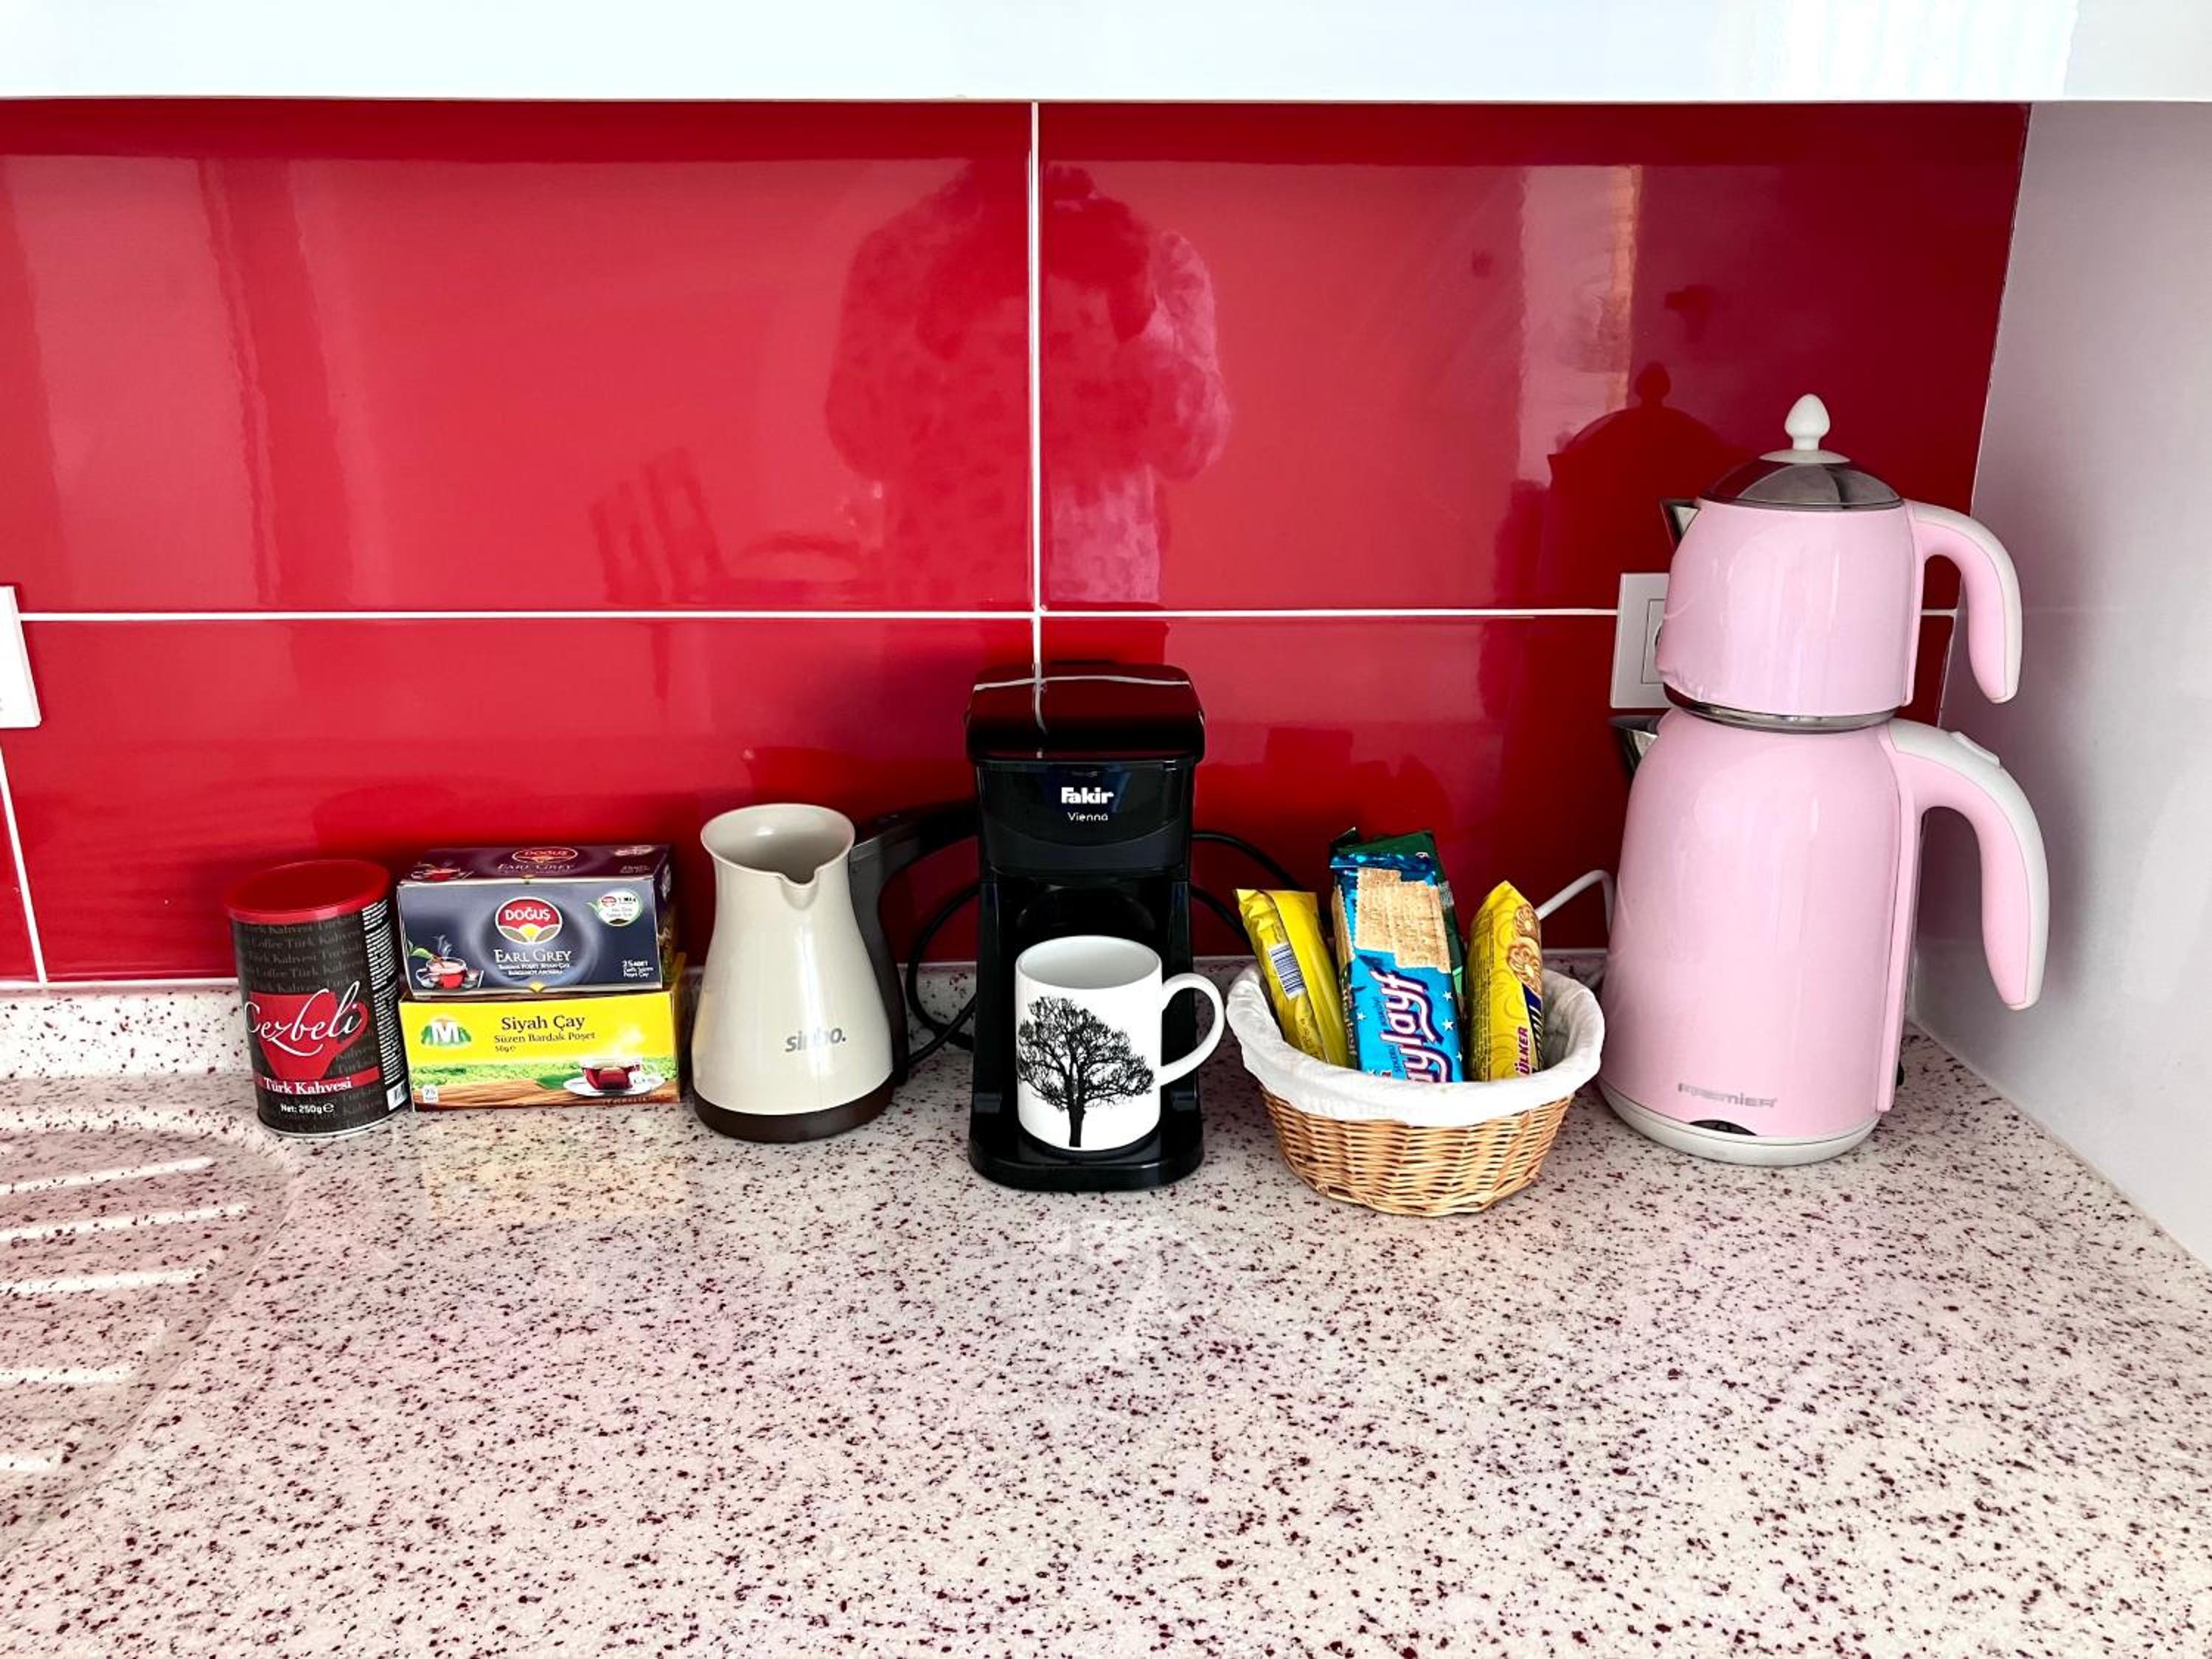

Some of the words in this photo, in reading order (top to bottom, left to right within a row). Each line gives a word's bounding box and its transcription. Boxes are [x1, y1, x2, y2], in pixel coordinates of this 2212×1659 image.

[1061, 787, 1114, 804] Fakir
[1067, 812, 1108, 821] Vienna
[504, 906, 551, 922] DOĞUŞ
[501, 1016, 548, 1033] Siyah
[553, 1015, 585, 1031] Çay
[494, 1034, 526, 1043] Süzen
[528, 1032, 566, 1042] Bardak
[568, 1031, 595, 1041] Poşet
[785, 1027, 846, 1052] sio.
[1514, 1026, 1530, 1075] ÜLKER
[264, 1077, 293, 1095] Türk
[295, 1077, 353, 1095] Kahvesi
